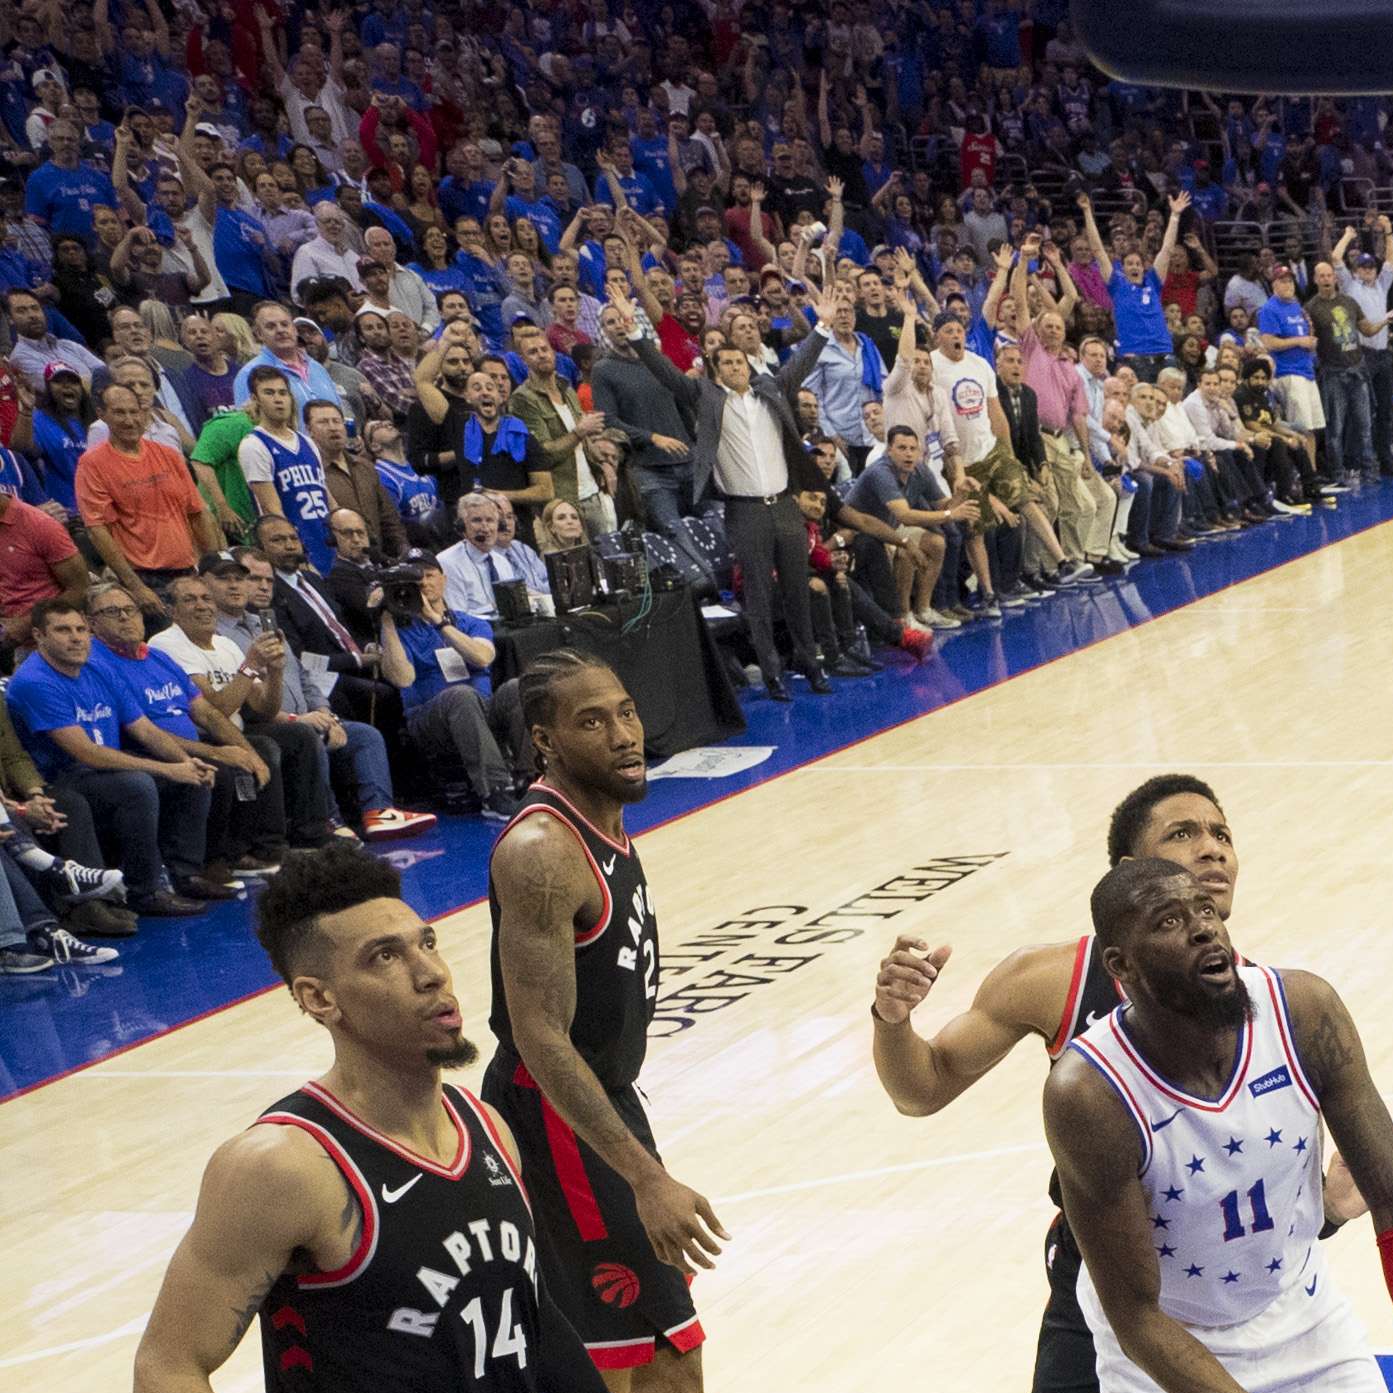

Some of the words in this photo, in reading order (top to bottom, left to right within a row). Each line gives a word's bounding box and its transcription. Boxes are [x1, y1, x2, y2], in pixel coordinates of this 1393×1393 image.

[296, 490, 329, 520] 25
[774, 851, 1011, 946] WELLS
[1220, 1178, 1274, 1243] 11
[386, 1218, 541, 1338] RAPTOR
[460, 1288, 527, 1379] 14
